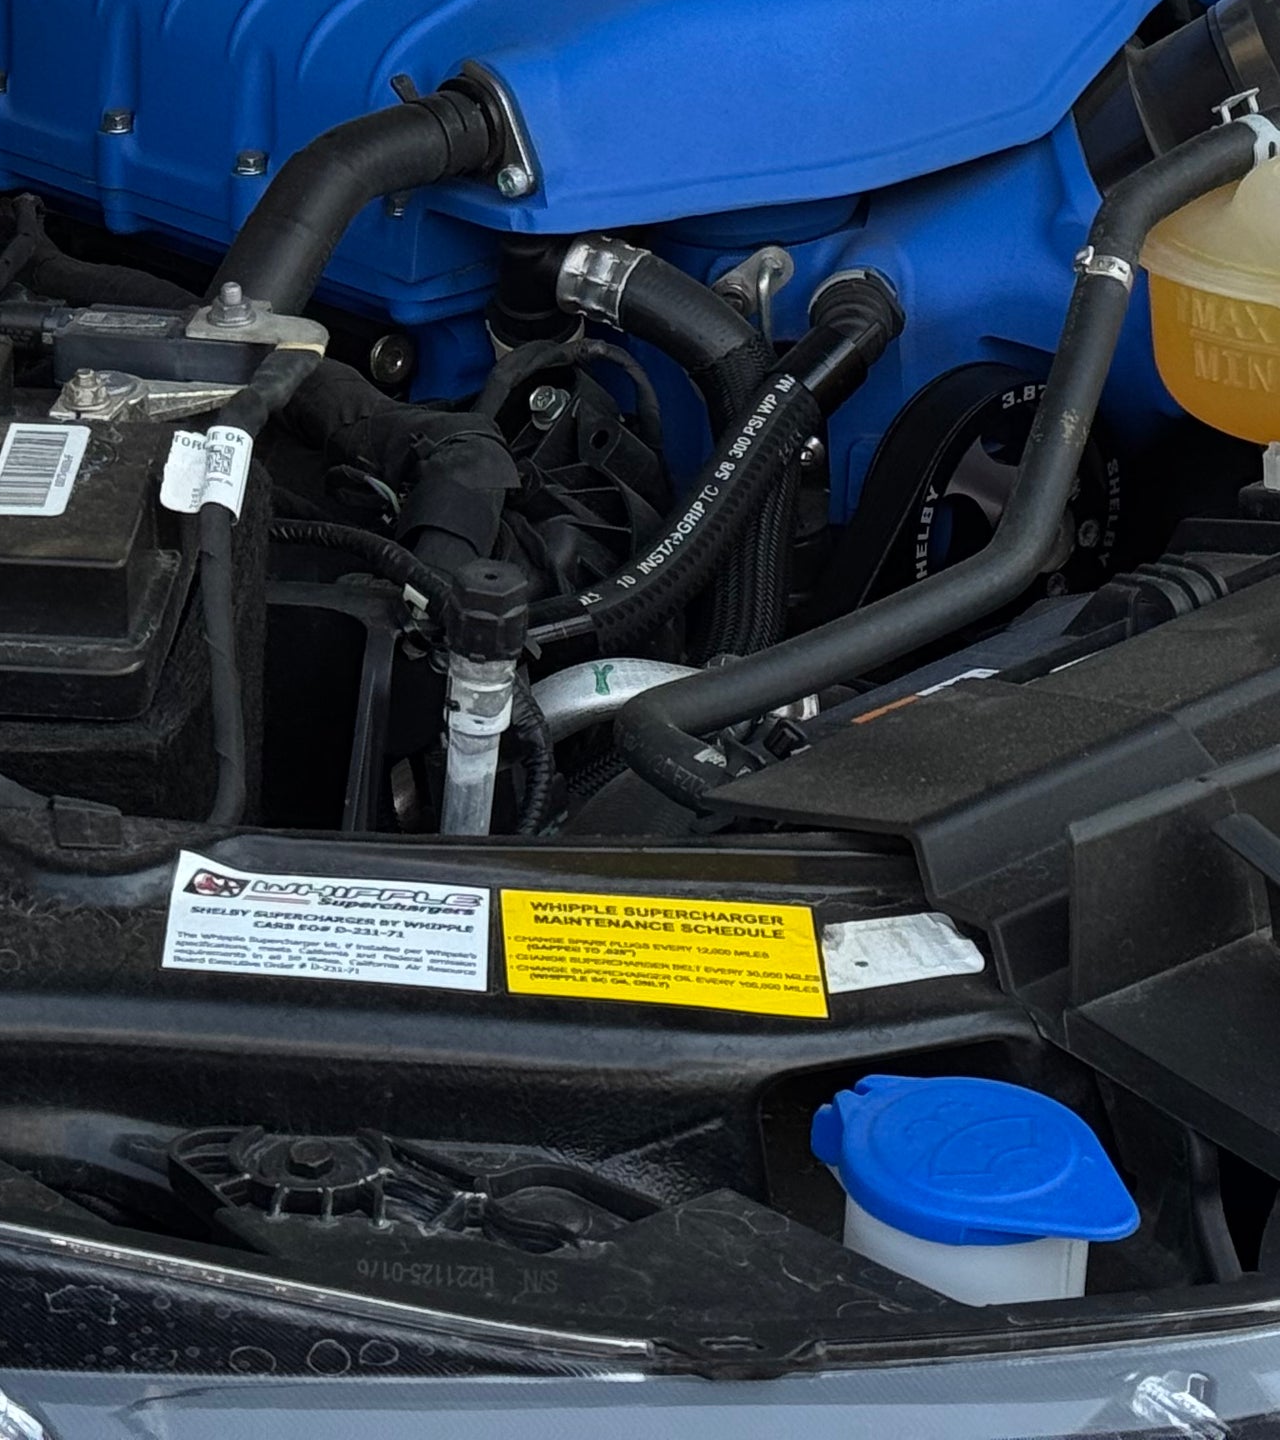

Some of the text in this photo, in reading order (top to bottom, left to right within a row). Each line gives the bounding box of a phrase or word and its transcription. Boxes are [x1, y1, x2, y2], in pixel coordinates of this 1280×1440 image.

[1191, 293, 1274, 343] MAX
[1193, 341, 1276, 393] MIN
[715, 460, 736, 481] 5/8
[729, 436, 752, 459] 300
[743, 415, 767, 438] PSI
[757, 393, 778, 416] WP
[916, 485, 939, 579] HELBY
[251, 880, 484, 908] WHIPPLE
[318, 898, 476, 916] Superchargers
[530, 901, 784, 926] WHIPPLE SUPERCHARGER
[190, 906, 474, 933] SHELBY SUPERCHARGER BY WHIPPLE
[253, 921, 294, 930] CARB
[534, 915, 785, 939] MAINTENANCE SCHEDULE
[177, 931, 197, 939] The
[201, 933, 245, 943] Whipple
[249, 936, 320, 949] Supercharger
[356, 944, 400, 953] installed
[299, 948, 350, 958] California
[514, 935, 565, 944] CHANGE
[568, 938, 607, 947] SPARK
[610, 940, 651, 950] PLUGS
[652, 944, 692, 953] EVERY
[734, 950, 770, 959] MILES
[264, 961, 294, 969] Order
[349, 959, 400, 969] California
[515, 953, 567, 962] CHANGE
[570, 956, 670, 970] SUPERCHARGER
[672, 964, 701, 972] BELT
[704, 966, 744, 976] EVERY
[785, 972, 820, 981] MILES
[516, 965, 567, 973] CHANGE
[571, 967, 671, 981] SUPERCHARGER
[696, 977, 736, 986] EVERY
[784, 985, 819, 993] MILES
[521, 1269, 559, 1293] S/N
